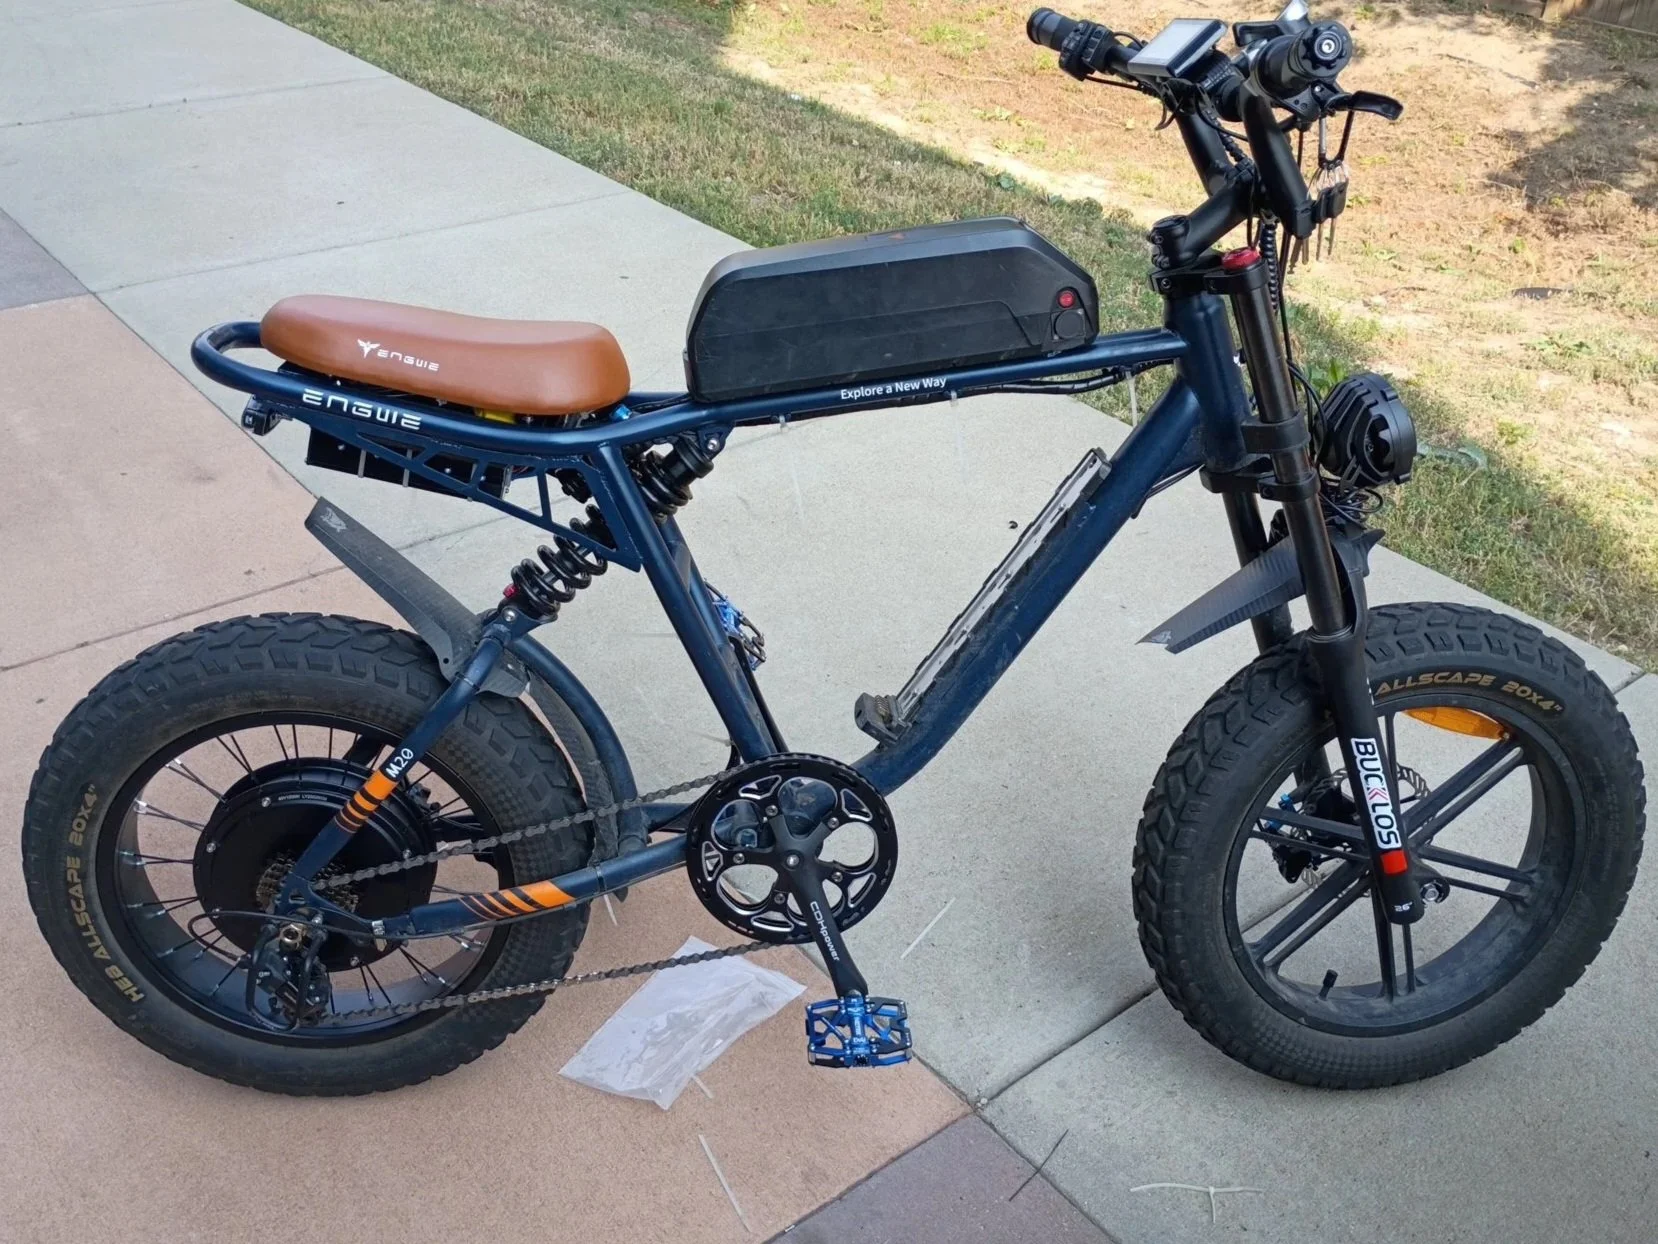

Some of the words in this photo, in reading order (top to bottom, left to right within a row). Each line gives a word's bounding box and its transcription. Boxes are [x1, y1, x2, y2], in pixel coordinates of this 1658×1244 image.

[840, 386, 883, 400] Explore
[885, 385, 893, 394] a
[895, 381, 921, 393] New
[922, 377, 947, 388] Way
[1375, 671, 1497, 697] ALLSCAPE
[385, 748, 414, 778] M20
[66, 855, 111, 961] ALLSCAPE
